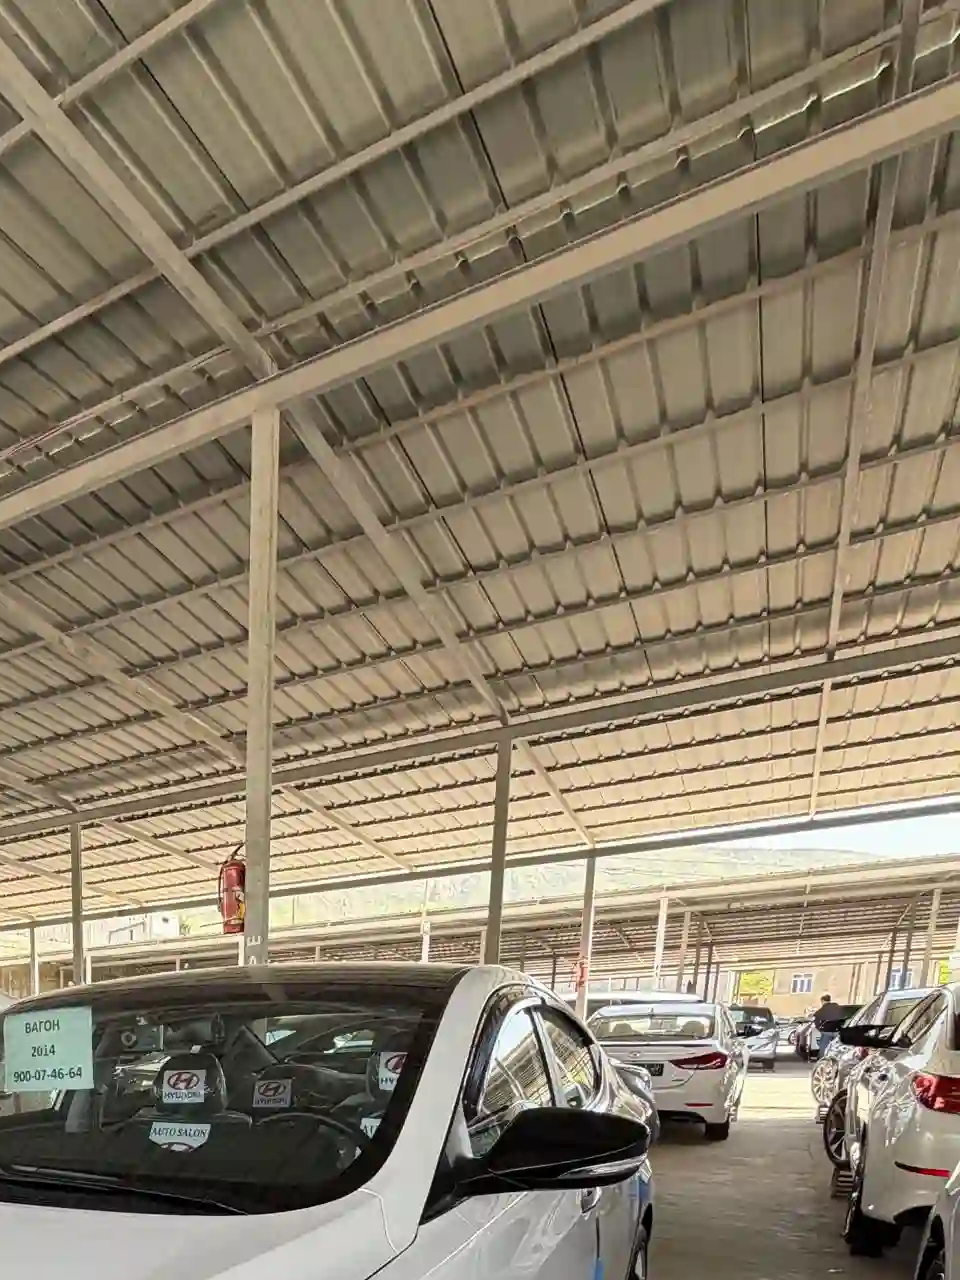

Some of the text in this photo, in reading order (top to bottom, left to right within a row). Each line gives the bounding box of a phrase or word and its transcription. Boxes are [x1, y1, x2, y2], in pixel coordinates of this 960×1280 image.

[24, 1019, 60, 1034] ВАГОН
[13, 1066, 82, 1083] 900-07-46-64
[151, 1127, 208, 1138] AUTO SALON
